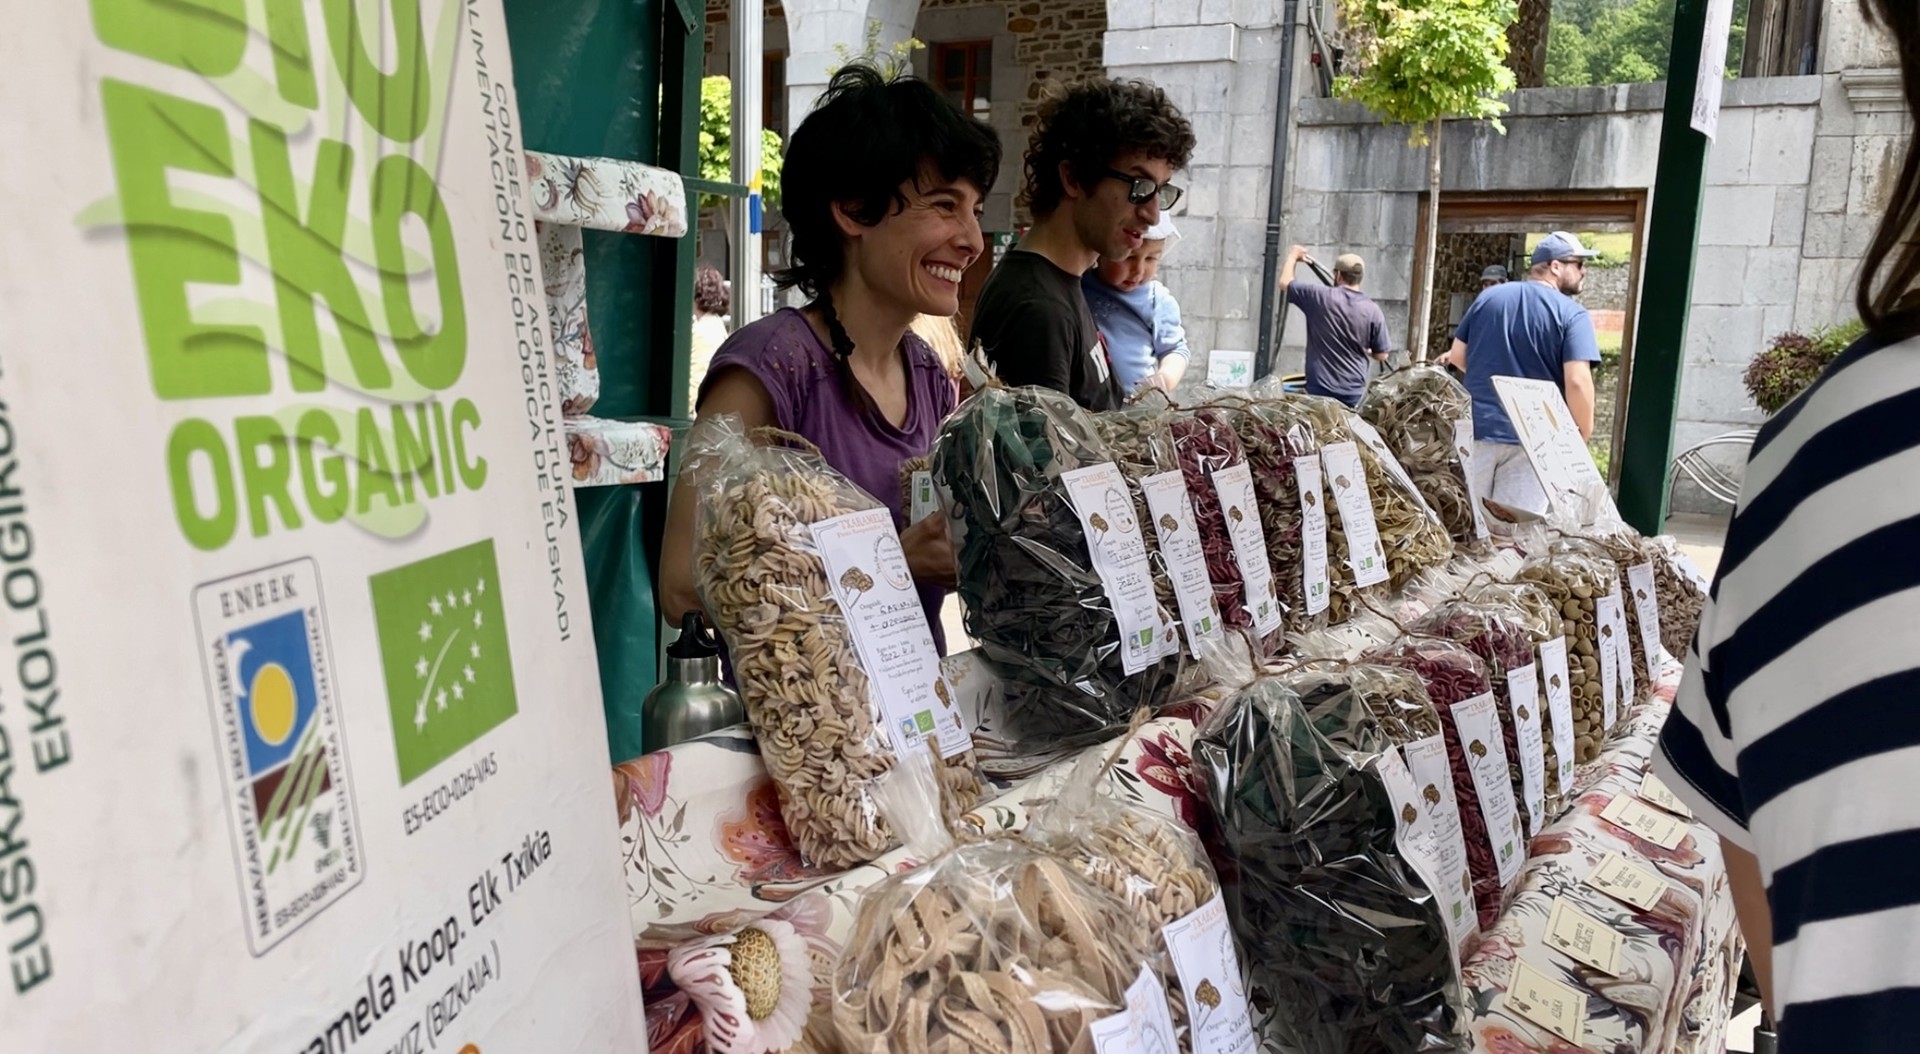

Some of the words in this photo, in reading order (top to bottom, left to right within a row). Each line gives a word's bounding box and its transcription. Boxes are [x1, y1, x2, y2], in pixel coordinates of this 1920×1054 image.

[101, 77, 468, 401] EKO
[495, 82, 528, 243] CONSEJO
[520, 253, 536, 296] DE
[165, 398, 488, 551] ORGANIC
[526, 303, 569, 529] AGRICULTURA
[534, 449, 550, 493] DE
[219, 574, 299, 618] ENEEK
[541, 501, 571, 643] EUSKADI
[398, 915, 466, 993] Koop.
[467, 869, 502, 927] Elk
[501, 829, 552, 893] Txikia
